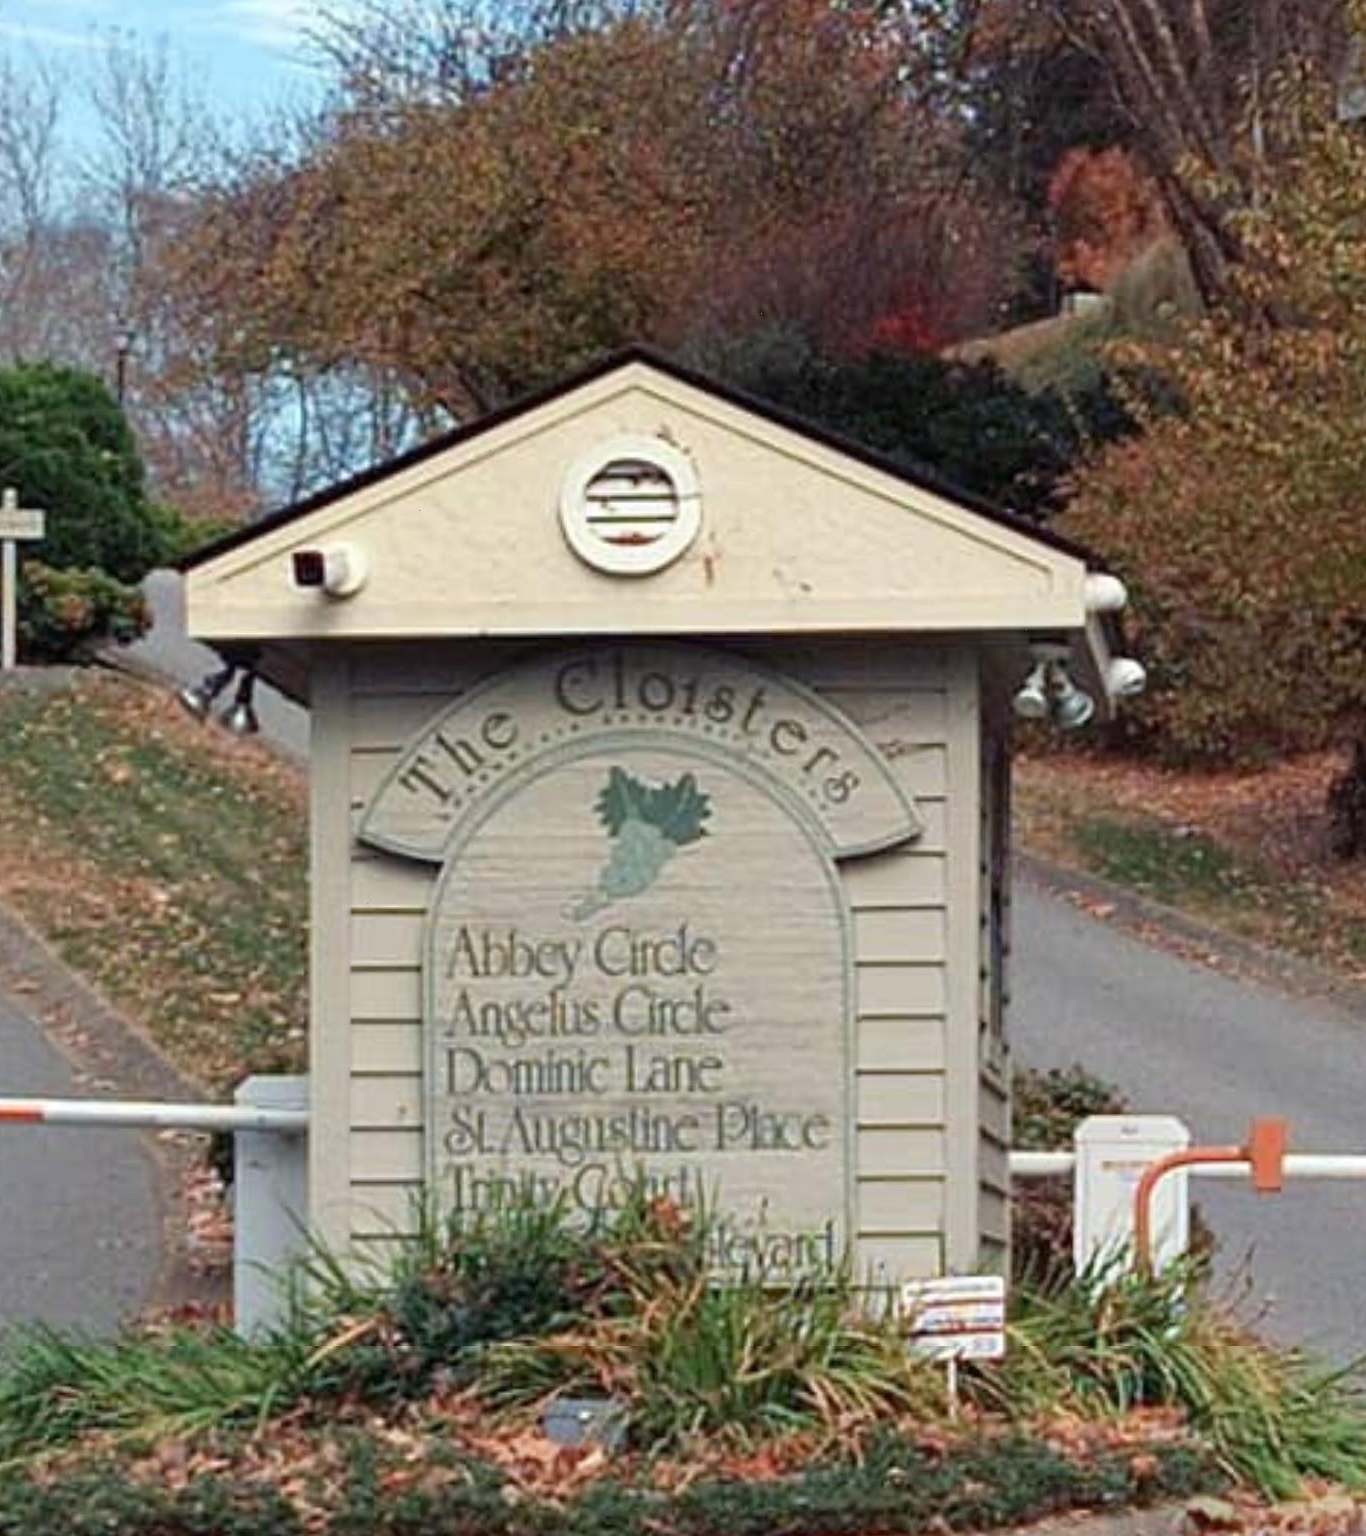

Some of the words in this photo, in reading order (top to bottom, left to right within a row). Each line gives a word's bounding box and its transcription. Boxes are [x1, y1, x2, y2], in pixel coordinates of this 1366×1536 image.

[399, 709, 519, 804] The
[553, 655, 861, 804] Cloisters
[446, 924, 582, 990] Abbey
[594, 922, 718, 977] Circle
[444, 987, 599, 1048] Angelus
[613, 983, 732, 1037] Circle
[446, 1046, 610, 1096] Dominic
[624, 1044, 723, 1095] Lane
[498, 1102, 701, 1168] Augustine
[715, 1102, 831, 1152] Place
